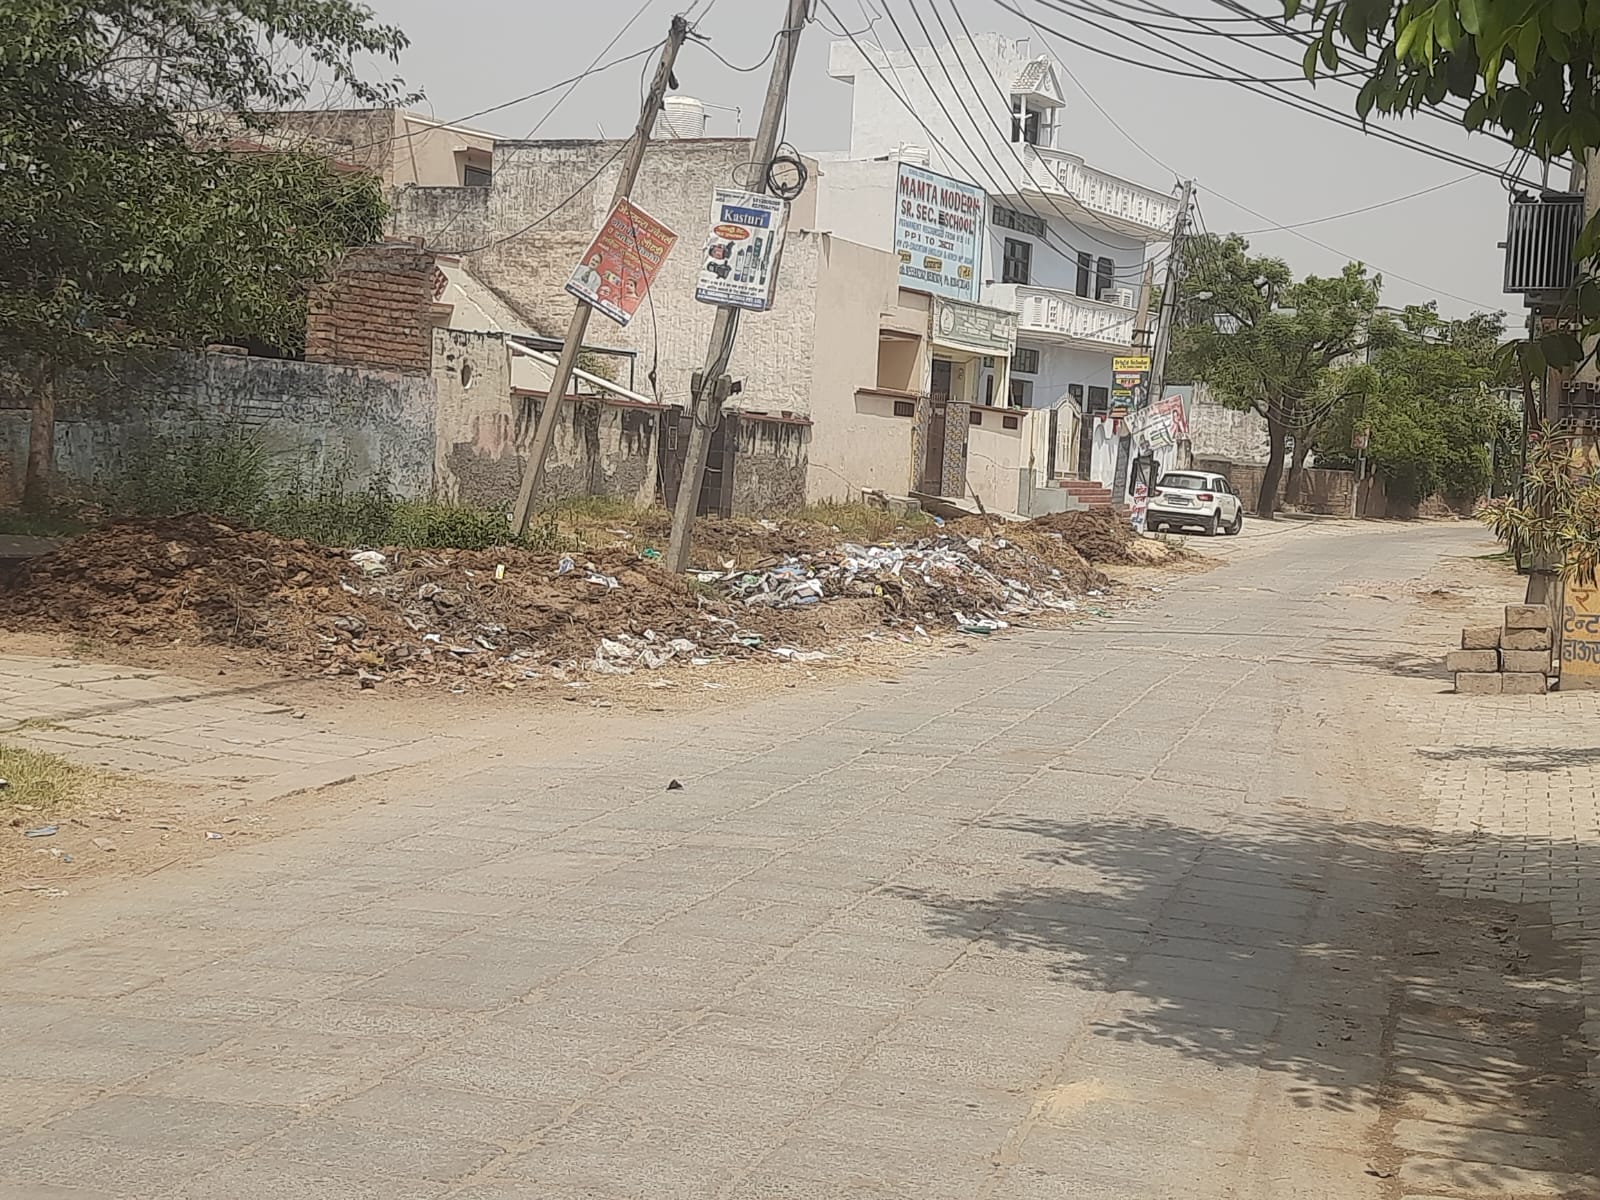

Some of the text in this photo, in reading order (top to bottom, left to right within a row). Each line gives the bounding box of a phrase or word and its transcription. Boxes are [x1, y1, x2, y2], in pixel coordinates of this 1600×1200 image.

[900, 175, 938, 206] MAMTA
[724, 208, 764, 226] Kasturi
[901, 199, 914, 218] SR.
[916, 203, 937, 225] SEC.
[944, 212, 974, 235] SCHOOL
